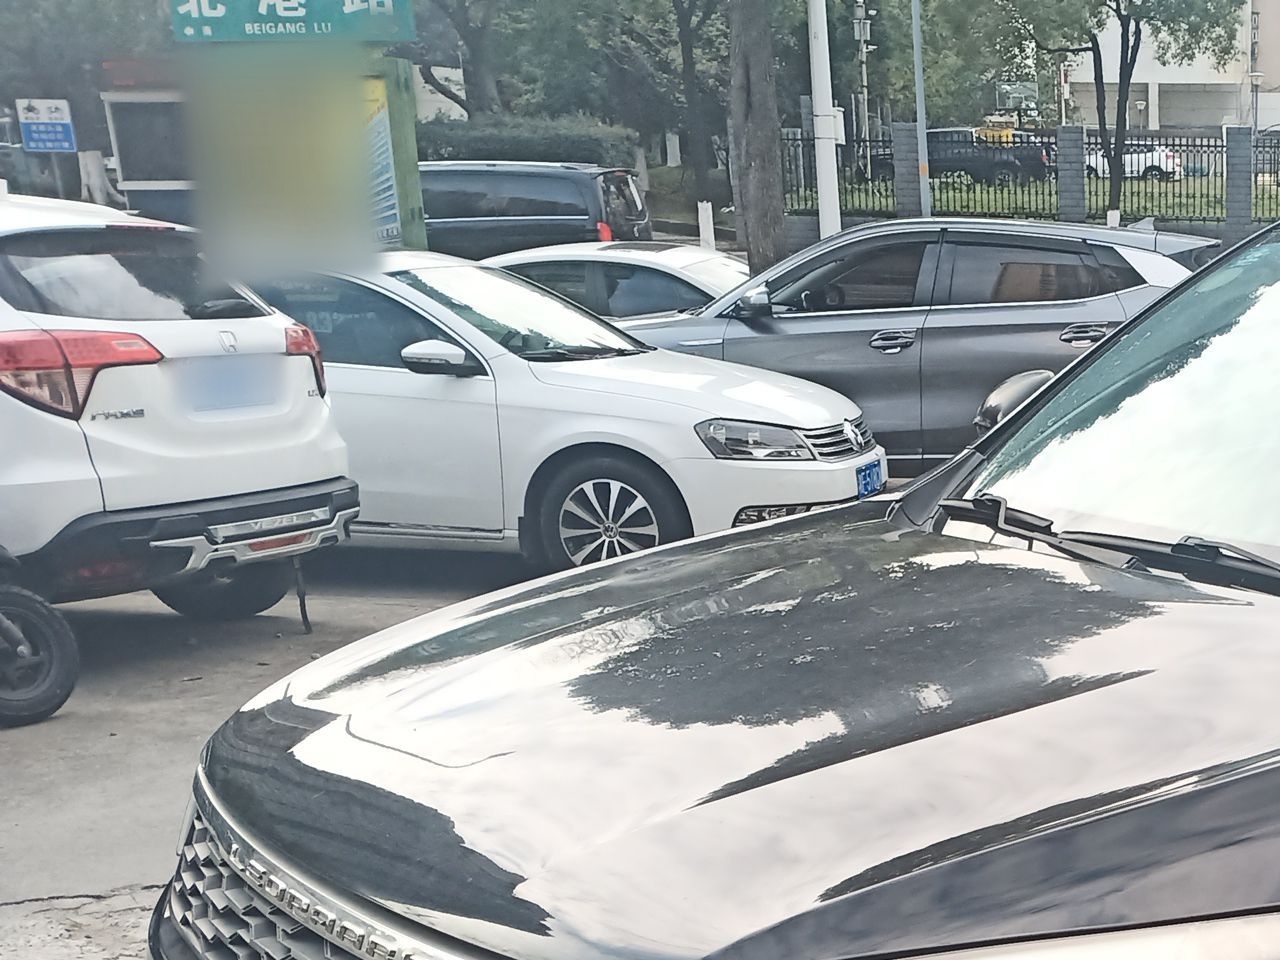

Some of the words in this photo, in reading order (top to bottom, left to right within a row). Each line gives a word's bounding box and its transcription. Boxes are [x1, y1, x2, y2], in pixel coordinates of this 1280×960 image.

[244, 22, 306, 35] BEIGANG
[314, 22, 331, 34] LU
[250, 515, 299, 531] VEZEL
